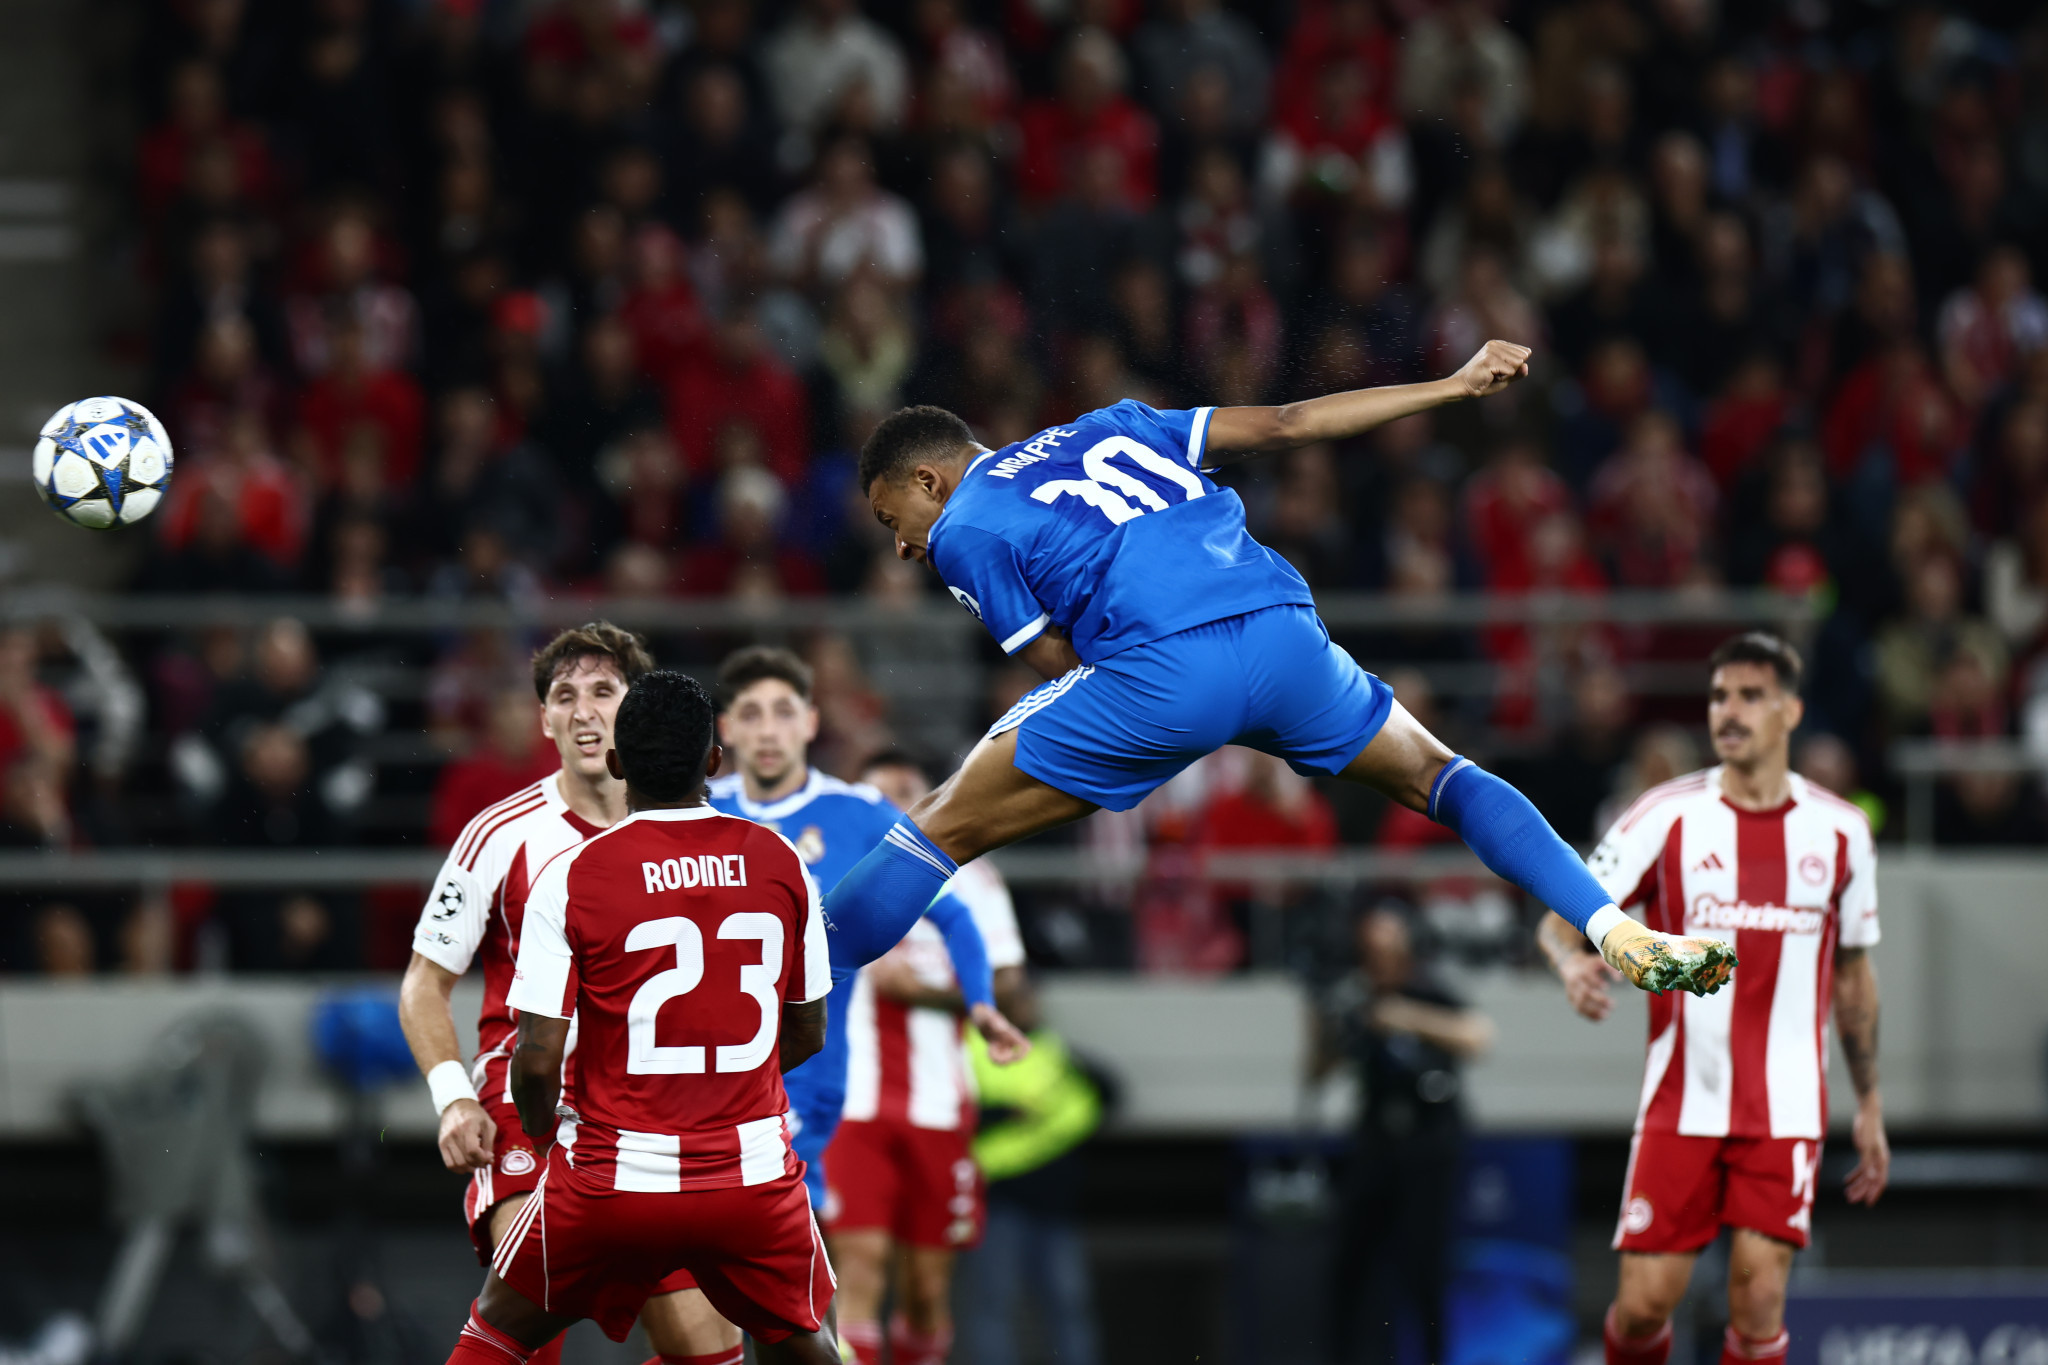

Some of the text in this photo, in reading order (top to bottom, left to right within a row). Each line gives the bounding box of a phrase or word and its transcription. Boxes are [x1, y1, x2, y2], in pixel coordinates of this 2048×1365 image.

[1029, 435, 1206, 526] 10
[641, 854, 748, 894] RODINEI
[624, 912, 785, 1075] 23
